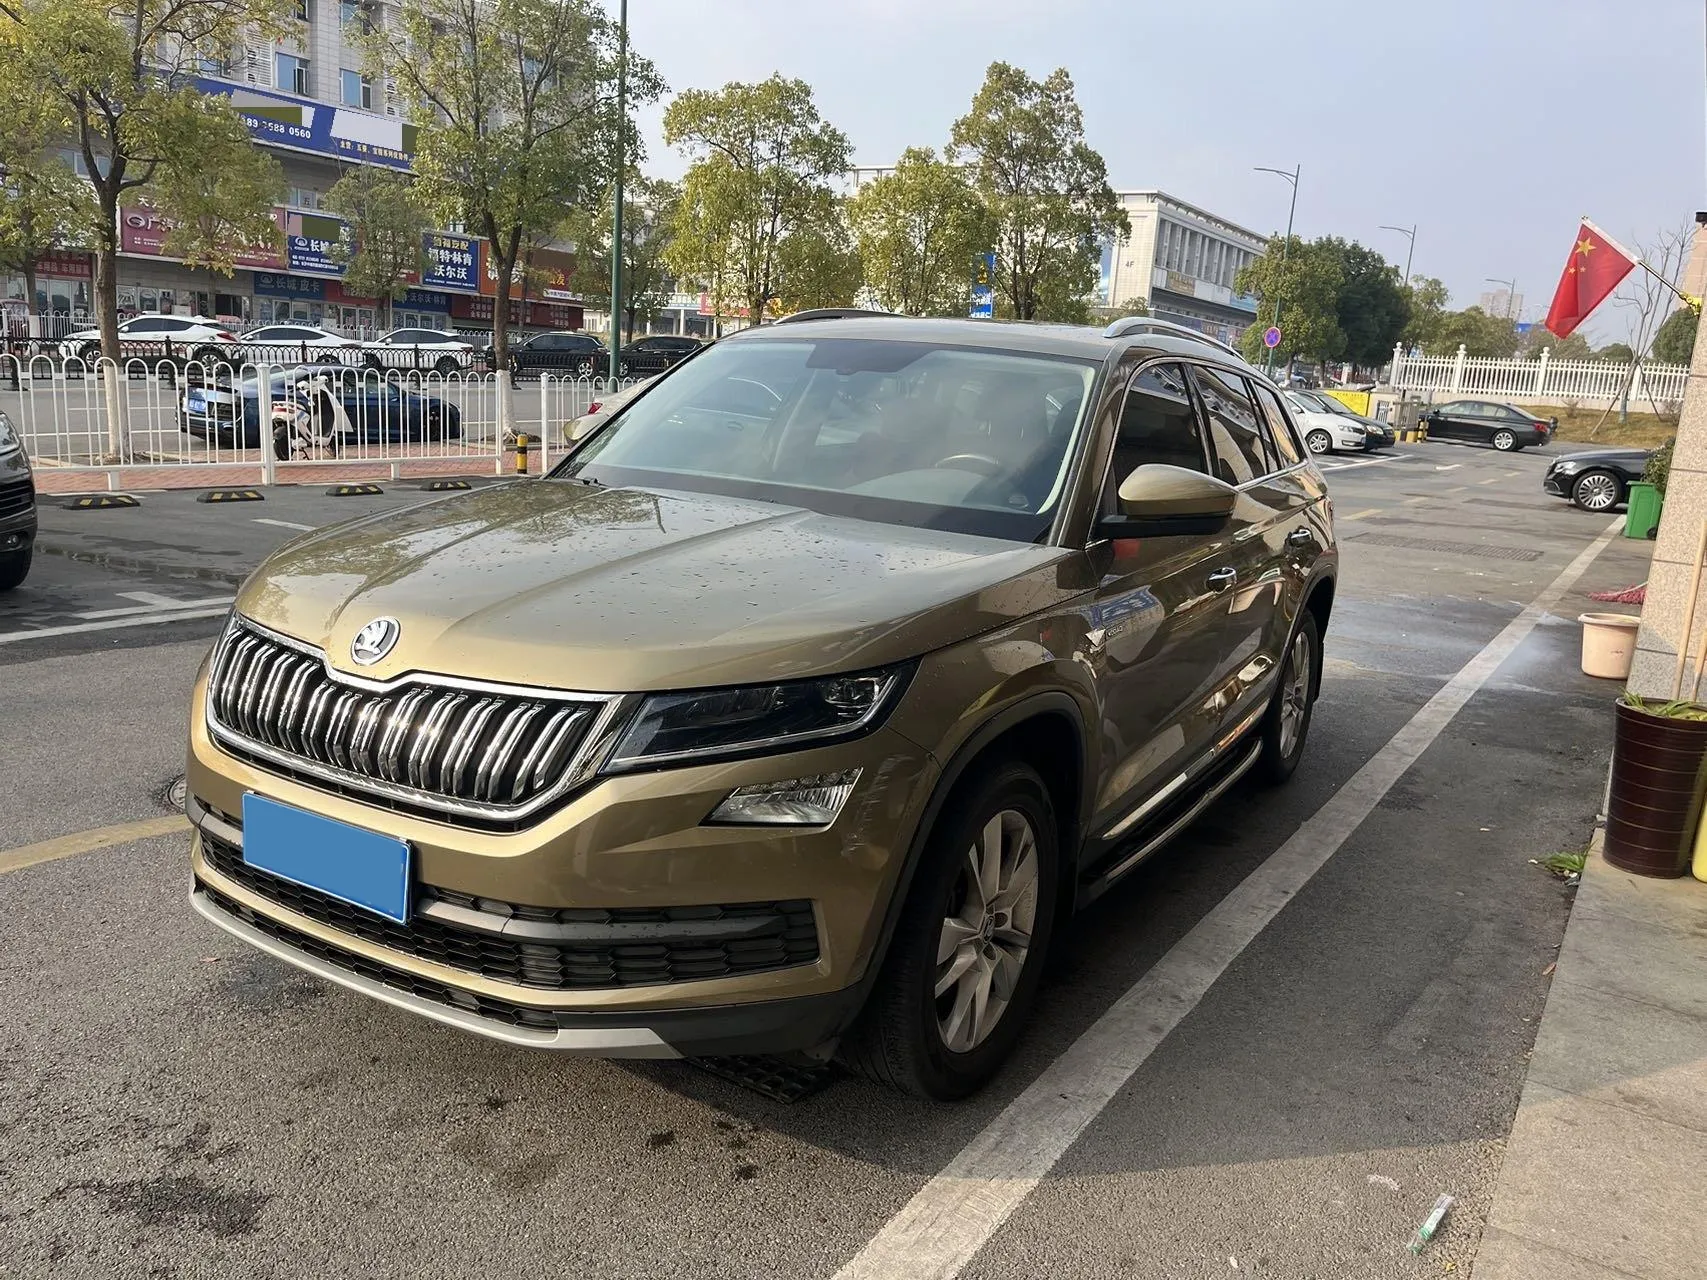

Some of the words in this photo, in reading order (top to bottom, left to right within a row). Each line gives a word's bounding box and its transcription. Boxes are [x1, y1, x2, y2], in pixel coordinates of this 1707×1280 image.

[289, 127, 311, 139] 0560
[434, 264, 468, 280] 沃尔沃
